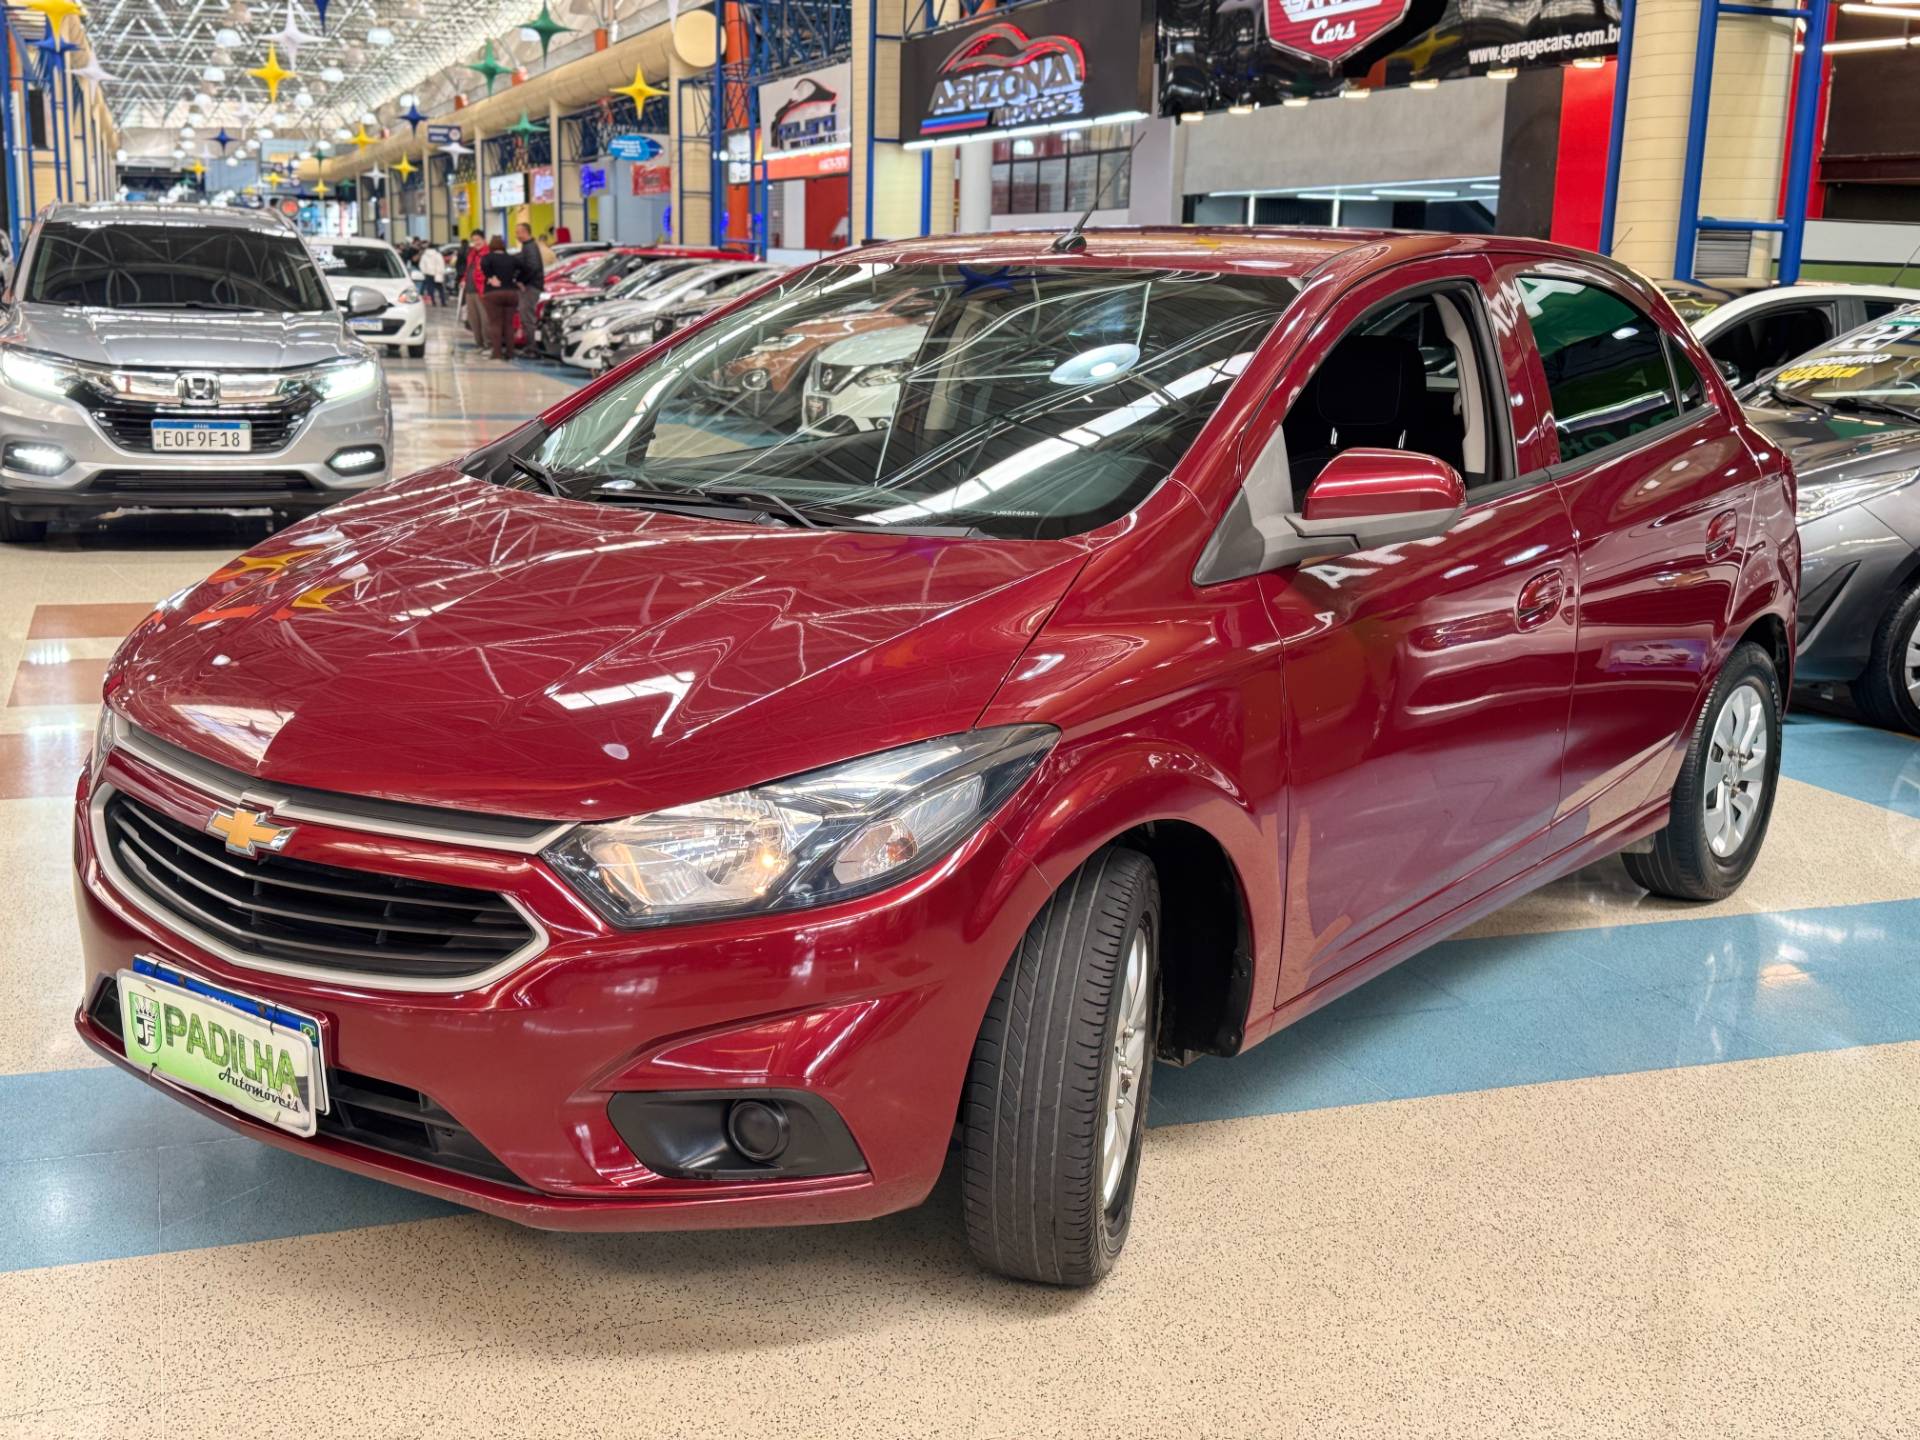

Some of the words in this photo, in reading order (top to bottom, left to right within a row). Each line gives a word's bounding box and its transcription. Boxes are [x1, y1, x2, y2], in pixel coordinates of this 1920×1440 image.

[1311, 18, 1357, 44] Cars
[928, 53, 1084, 115] ARIZONA
[163, 1002, 300, 1099] PADILHA
[218, 1067, 301, 1113] Automóveis
